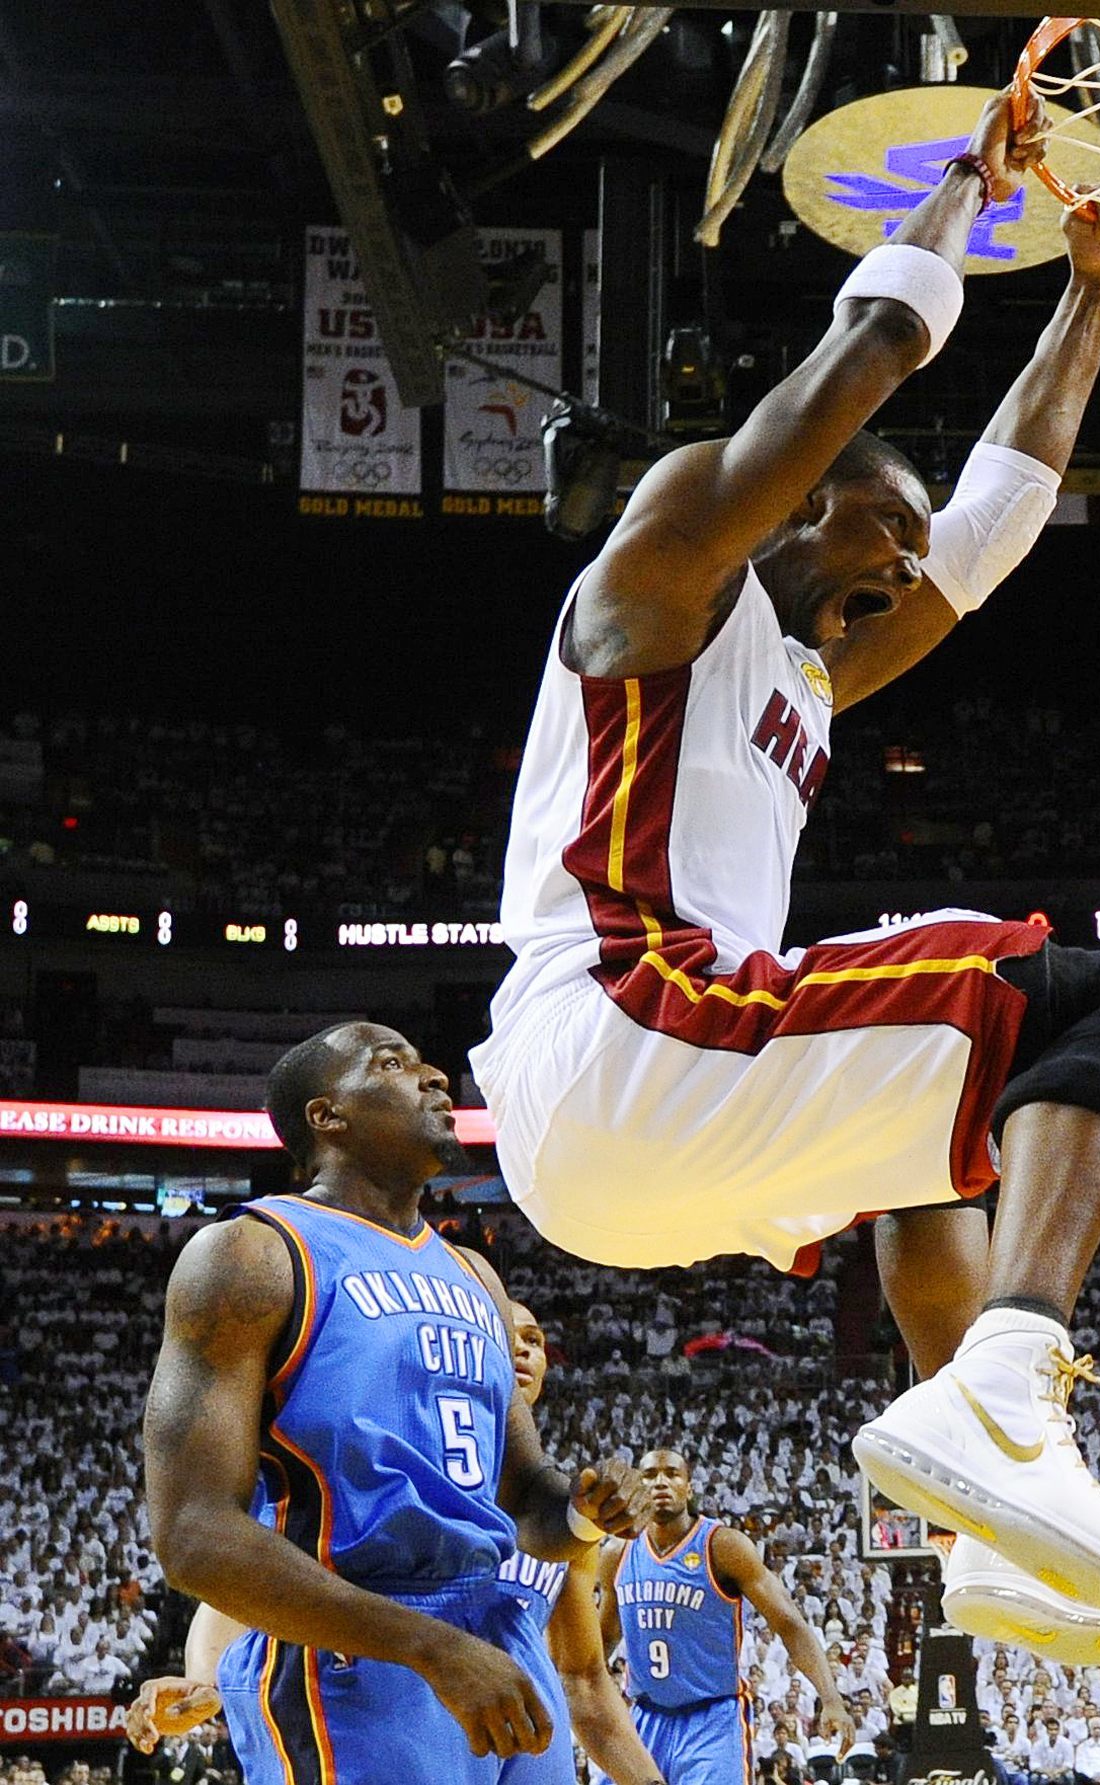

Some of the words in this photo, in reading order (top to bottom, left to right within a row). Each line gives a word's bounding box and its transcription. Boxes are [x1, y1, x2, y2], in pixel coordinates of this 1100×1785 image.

[319, 308, 374, 339] US
[496, 497, 544, 517] MED
[750, 687, 831, 813] HEA
[338, 922, 429, 946] HUSTLE
[431, 922, 505, 945] STATS
[0, 1109, 66, 1134] EASE
[70, 1113, 157, 1137] DRINK
[160, 1117, 276, 1140] RESPONS
[417, 1322, 487, 1384] CITY
[435, 1395, 485, 1492] 5
[616, 1580, 705, 1612] OKLAHOMA
[637, 1606, 675, 1630] CITY
[648, 1638, 671, 1680] 9
[0, 1704, 128, 1733] OSHIBA
